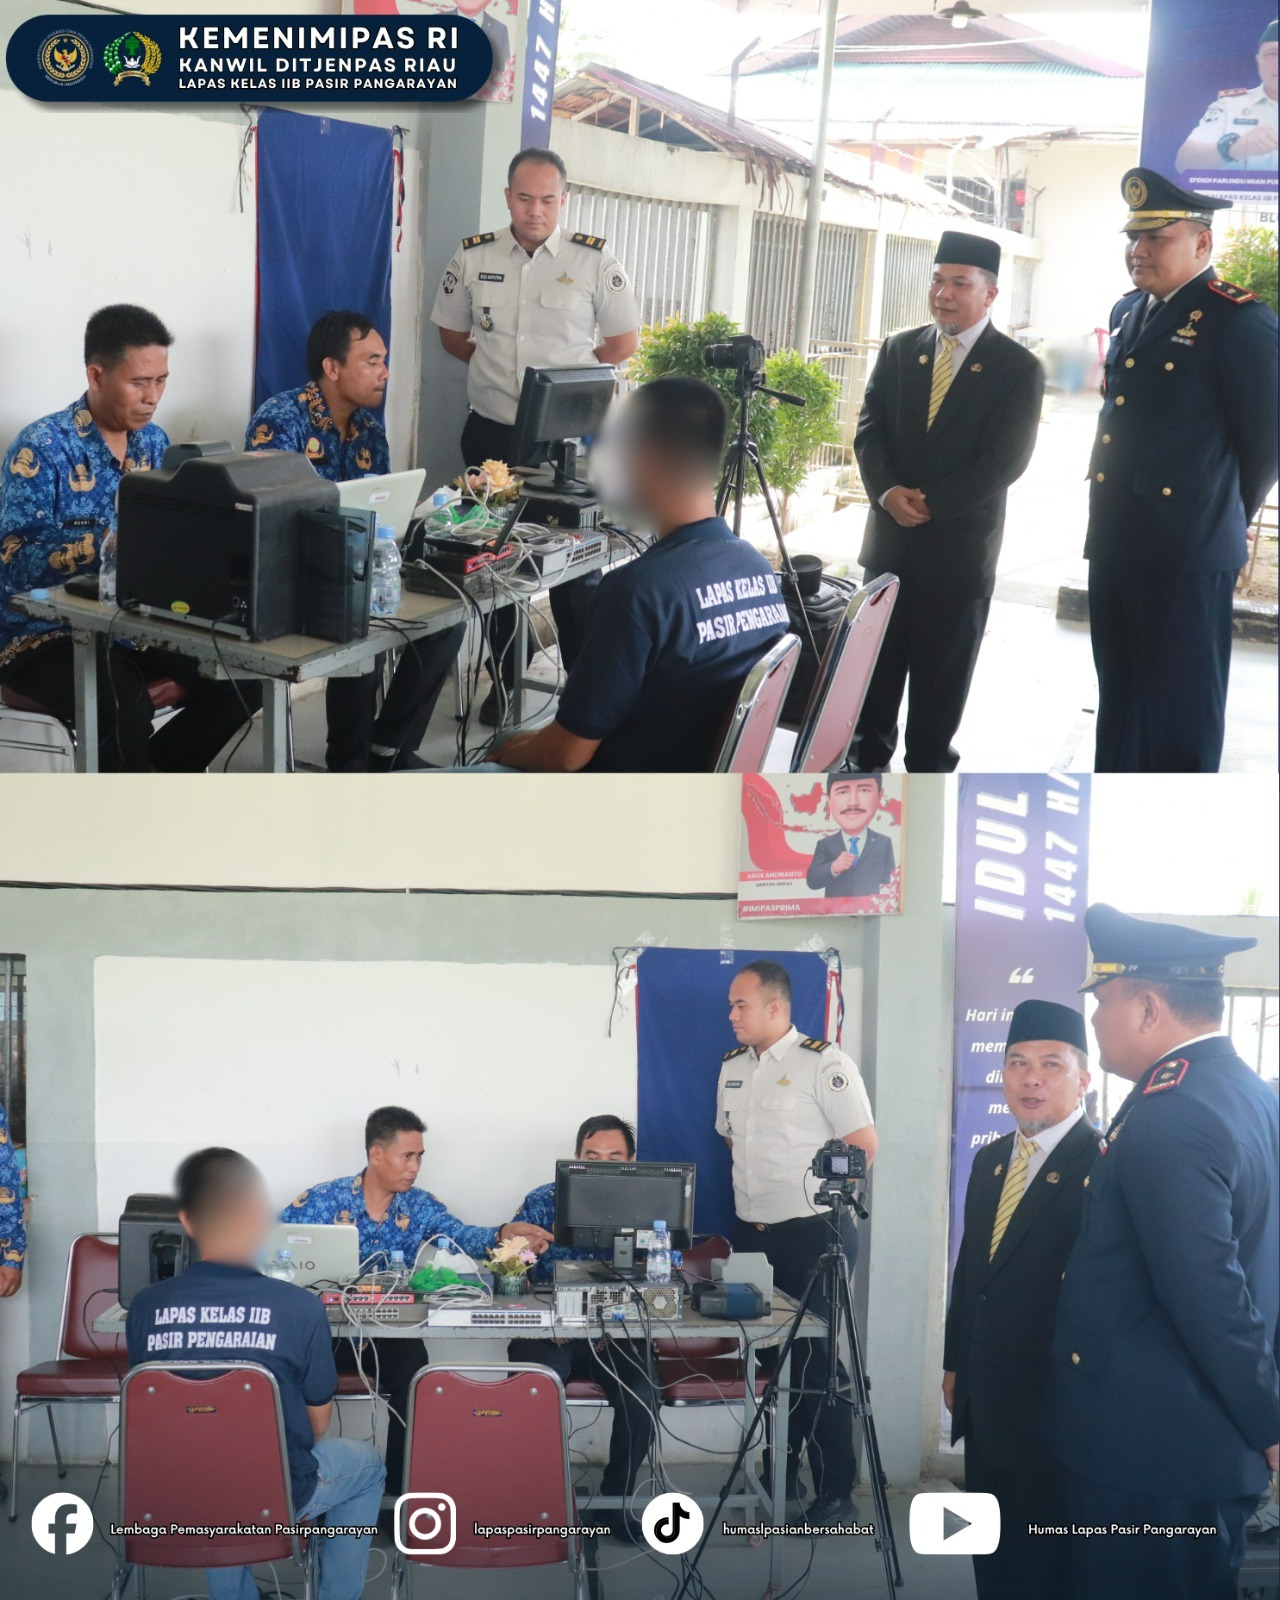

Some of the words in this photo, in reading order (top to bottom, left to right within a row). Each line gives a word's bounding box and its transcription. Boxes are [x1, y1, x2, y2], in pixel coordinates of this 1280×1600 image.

[539, 0, 556, 24] H
[530, 34, 552, 122] 1447
[1259, 212, 1278, 223] BL
[695, 580, 735, 610] LAPAS
[734, 575, 766, 600] KELAS
[696, 613, 737, 645] PASIR
[974, 791, 1029, 921] IDUL
[1043, 829, 1079, 923] 1447
[742, 904, 800, 912] #IMIPASPRIMA
[965, 1008, 998, 1022] Hari
[988, 1103, 1012, 1114] me
[970, 1132, 1005, 1148] prib
[155, 1306, 196, 1326] LAPAS
[200, 1306, 246, 1324] KELAS
[249, 1306, 271, 1325] IIB
[147, 1331, 184, 1352] PASIR
[187, 1331, 277, 1351] PENGARAIAN
